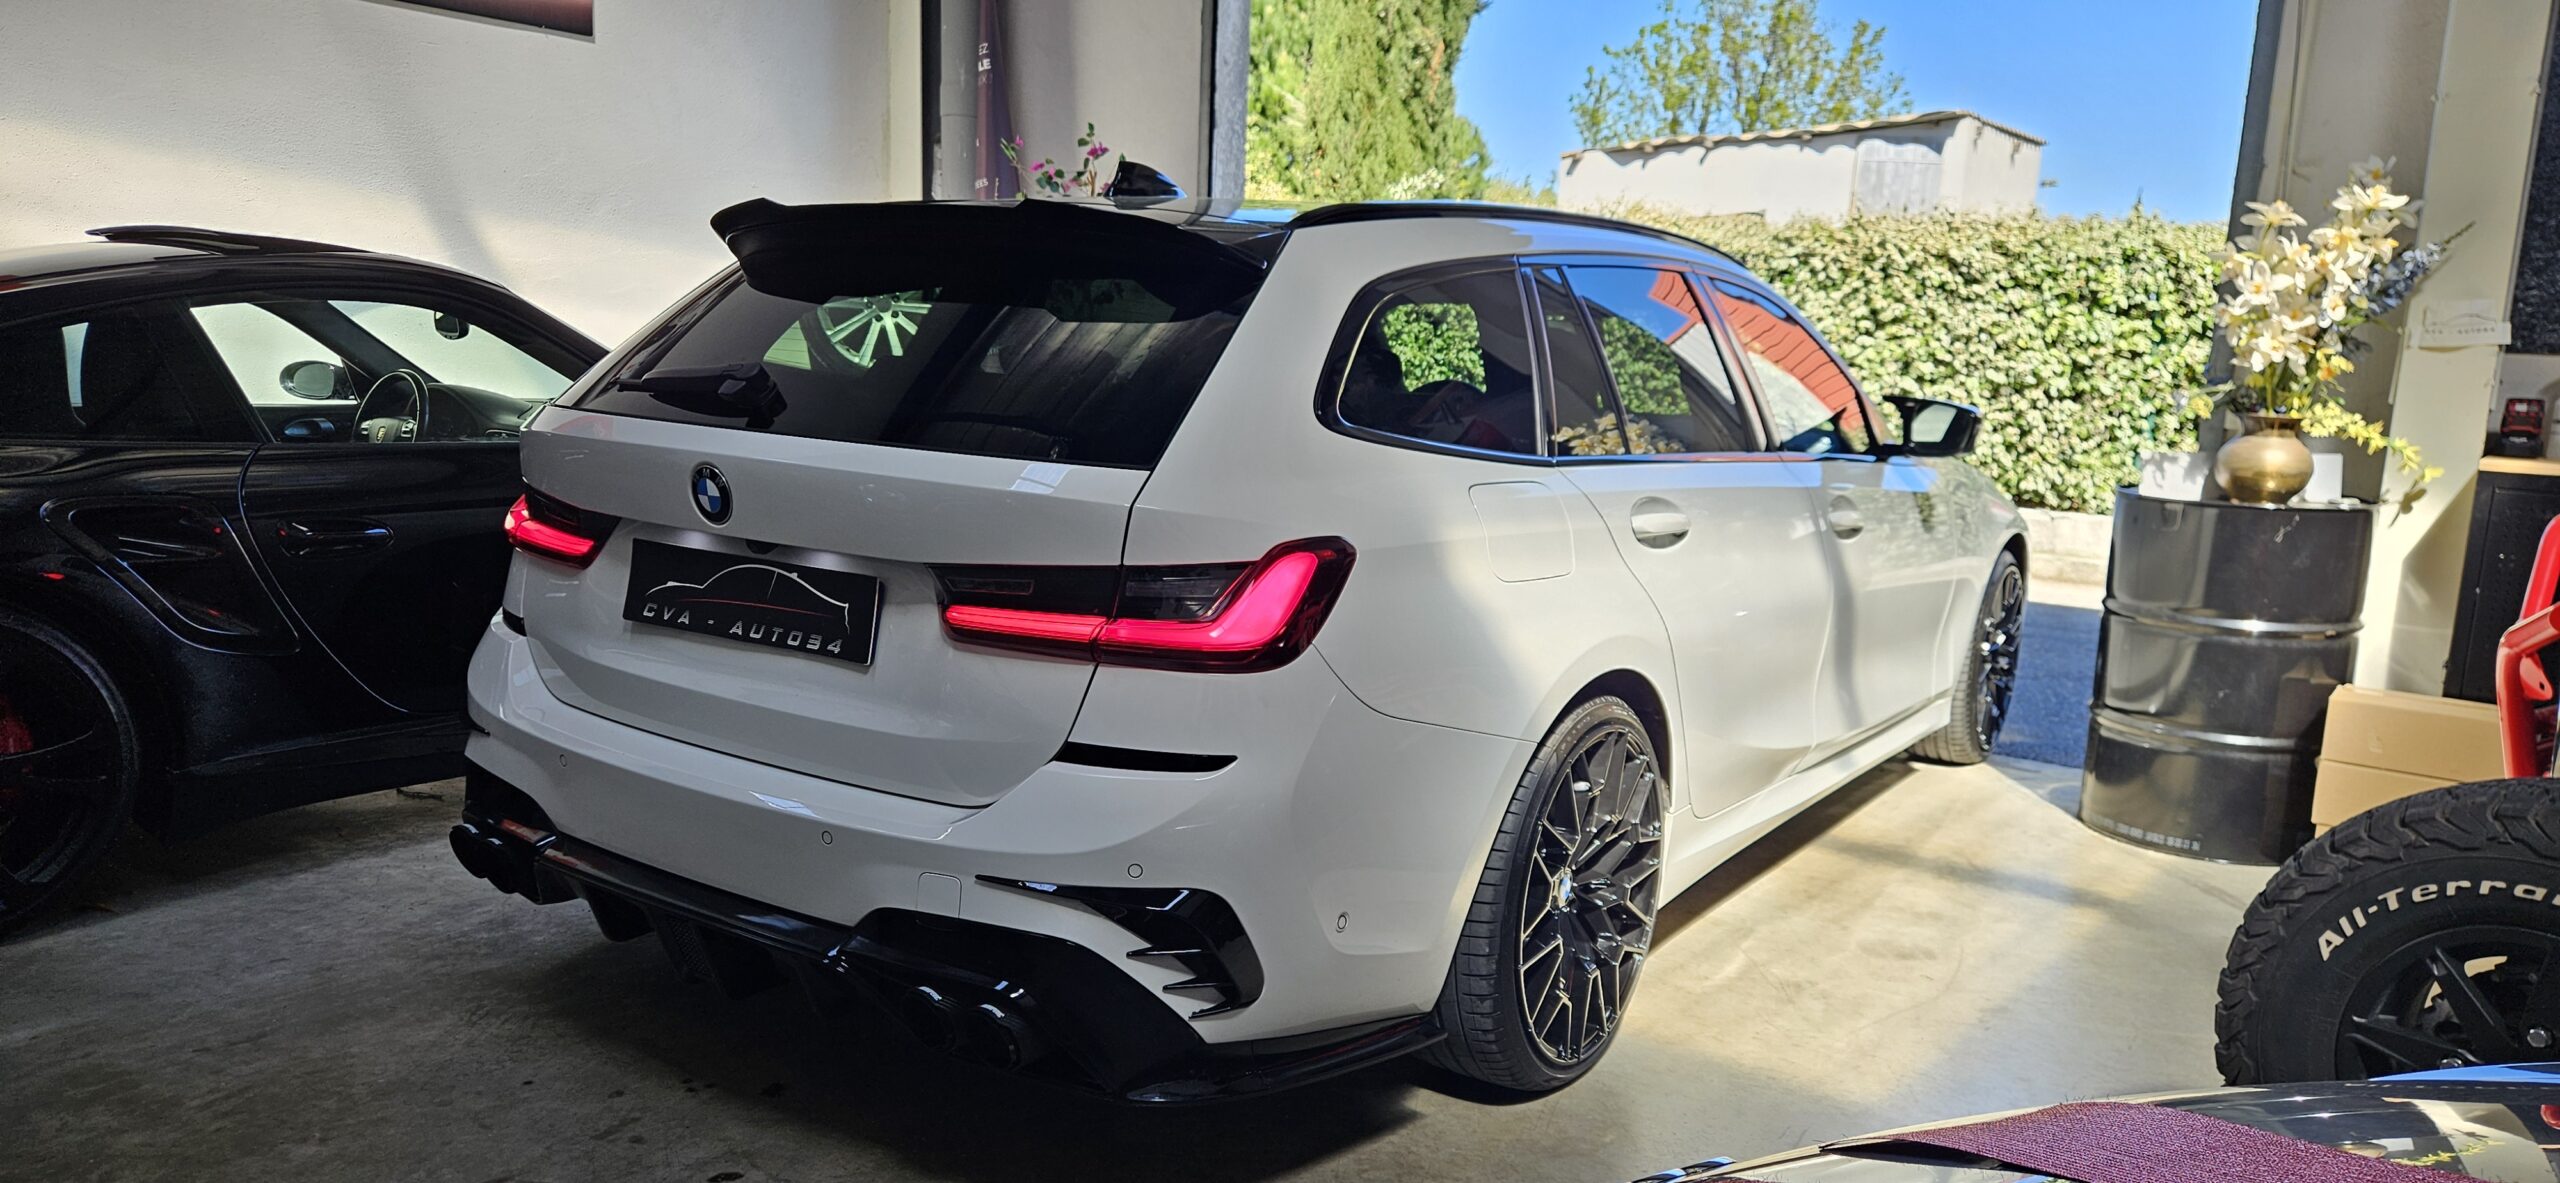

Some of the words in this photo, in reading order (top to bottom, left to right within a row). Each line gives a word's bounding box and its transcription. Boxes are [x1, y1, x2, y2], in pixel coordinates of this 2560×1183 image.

[643, 602, 690, 625] CVA
[728, 620, 843, 654] AUTO34
[2317, 880, 2560, 962] All-Terra
